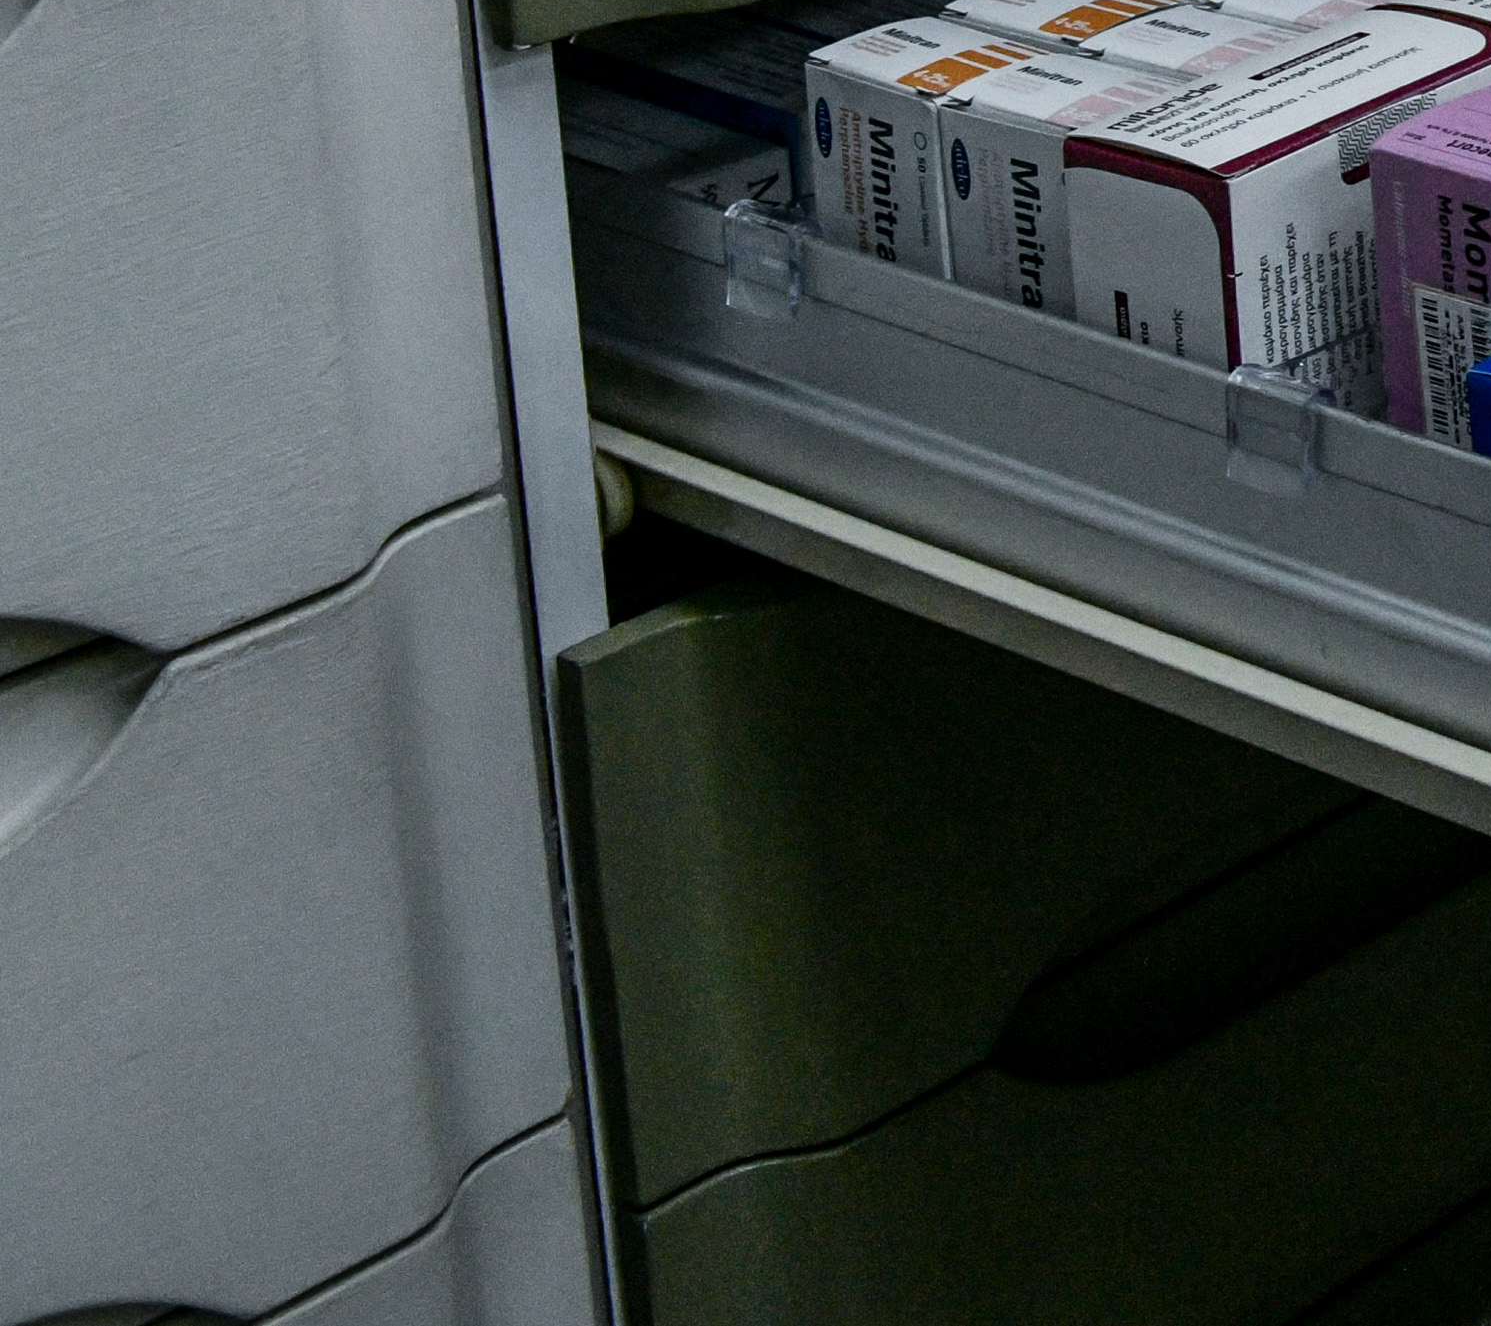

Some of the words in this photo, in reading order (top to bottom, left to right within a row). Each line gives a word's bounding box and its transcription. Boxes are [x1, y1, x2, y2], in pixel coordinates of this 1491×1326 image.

[881, 27, 942, 50] Minitran
[1145, 17, 1211, 39] Minitran
[1020, 64, 1083, 87] Minitran
[1107, 81, 1222, 131] miflonide
[815, 97, 832, 158] adelco
[1181, 136, 1200, 148] 60
[869, 117, 899, 264] Minitra
[1010, 158, 1045, 309] Minitra
